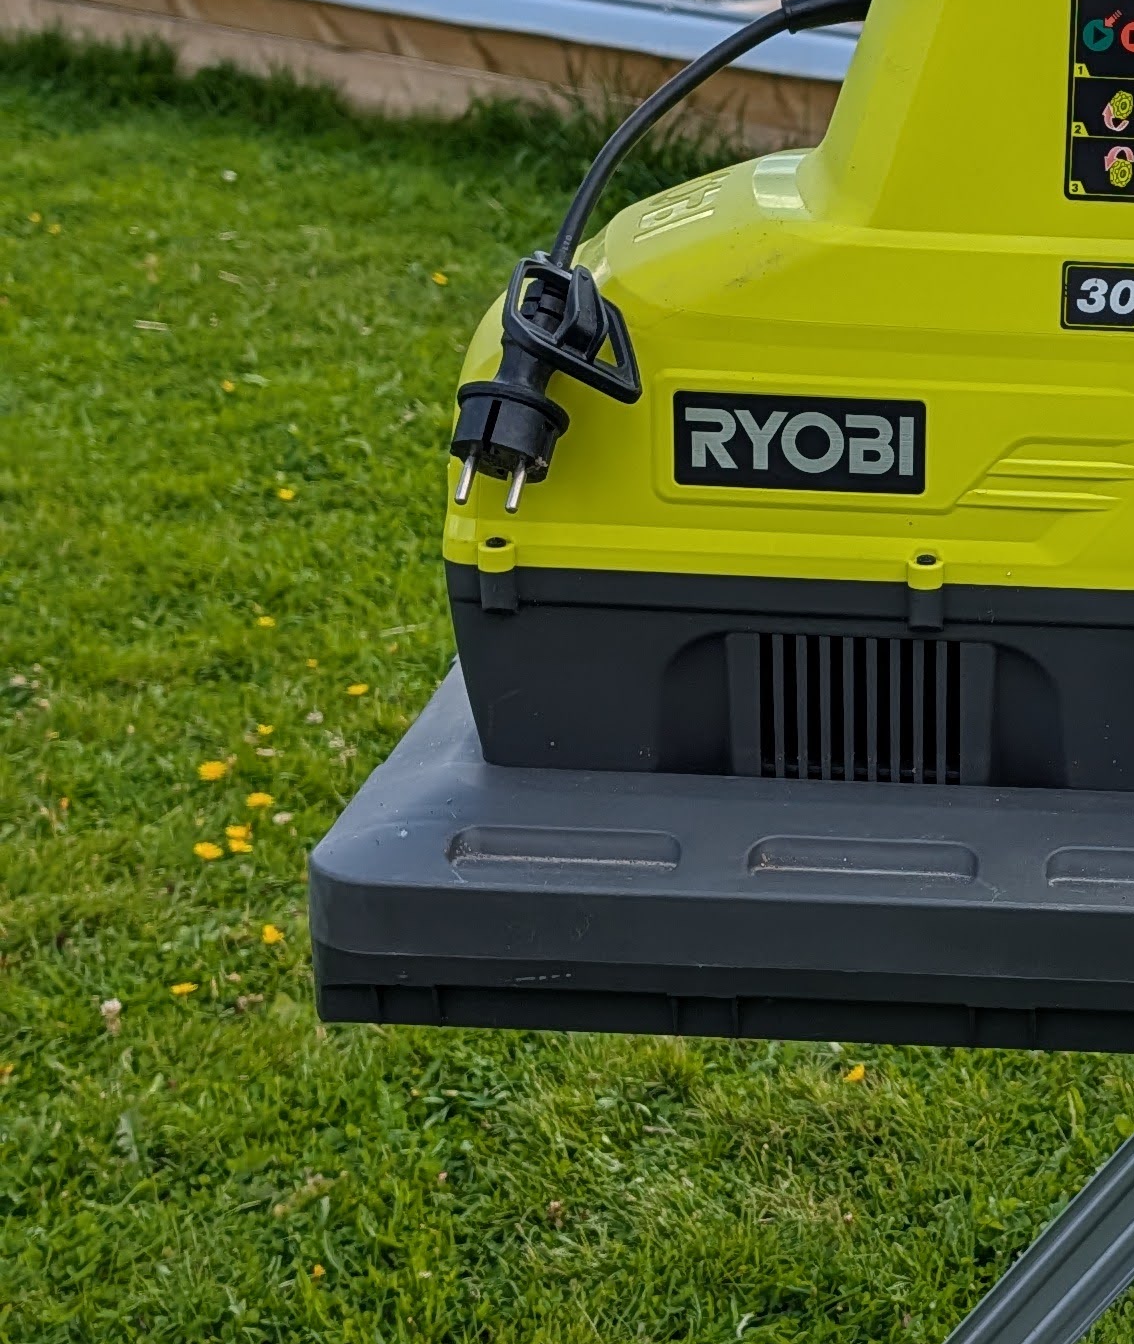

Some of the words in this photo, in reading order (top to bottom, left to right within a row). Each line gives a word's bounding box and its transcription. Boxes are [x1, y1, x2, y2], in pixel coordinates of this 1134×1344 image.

[1073, 125, 1082, 134] 2
[1071, 183, 1079, 193] 3
[685, 407, 915, 476] RYOBI
